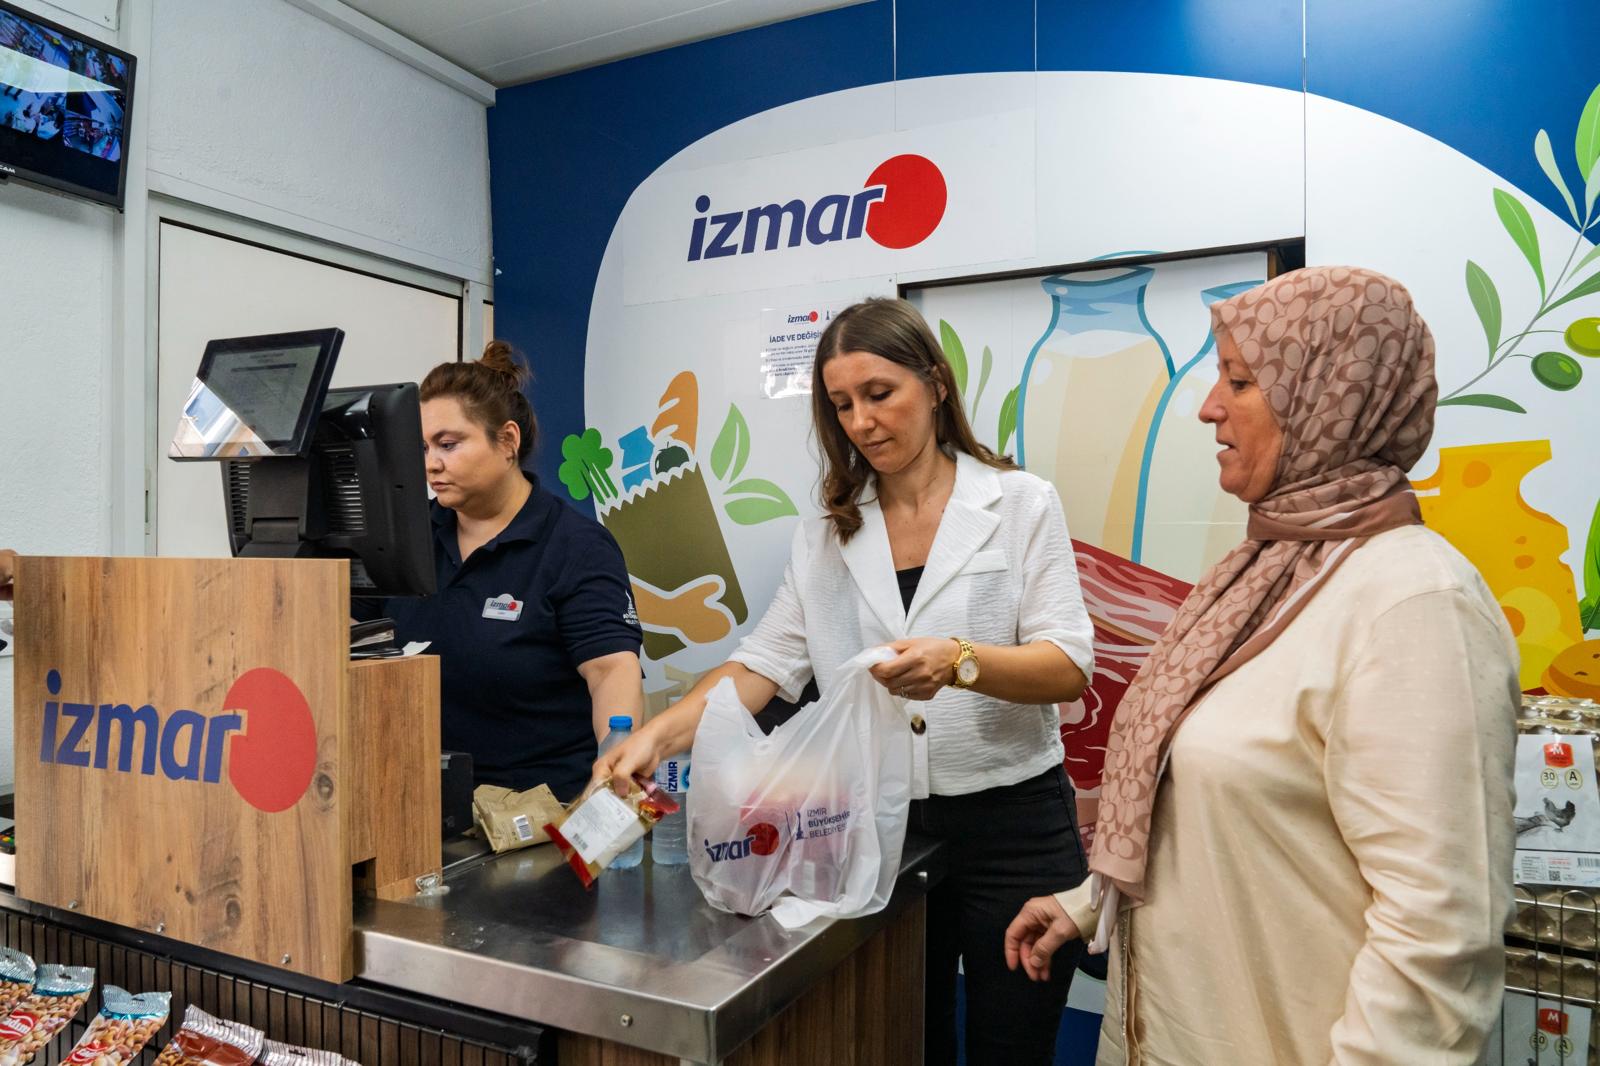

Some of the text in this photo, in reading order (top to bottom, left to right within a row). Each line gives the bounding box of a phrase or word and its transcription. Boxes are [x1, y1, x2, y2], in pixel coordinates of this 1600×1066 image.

[687, 194, 885, 262] izmar
[769, 335, 785, 343] İADE
[787, 334, 796, 342] VE
[40, 668, 243, 784] izmar
[1543, 771, 1578, 780] 30 A
